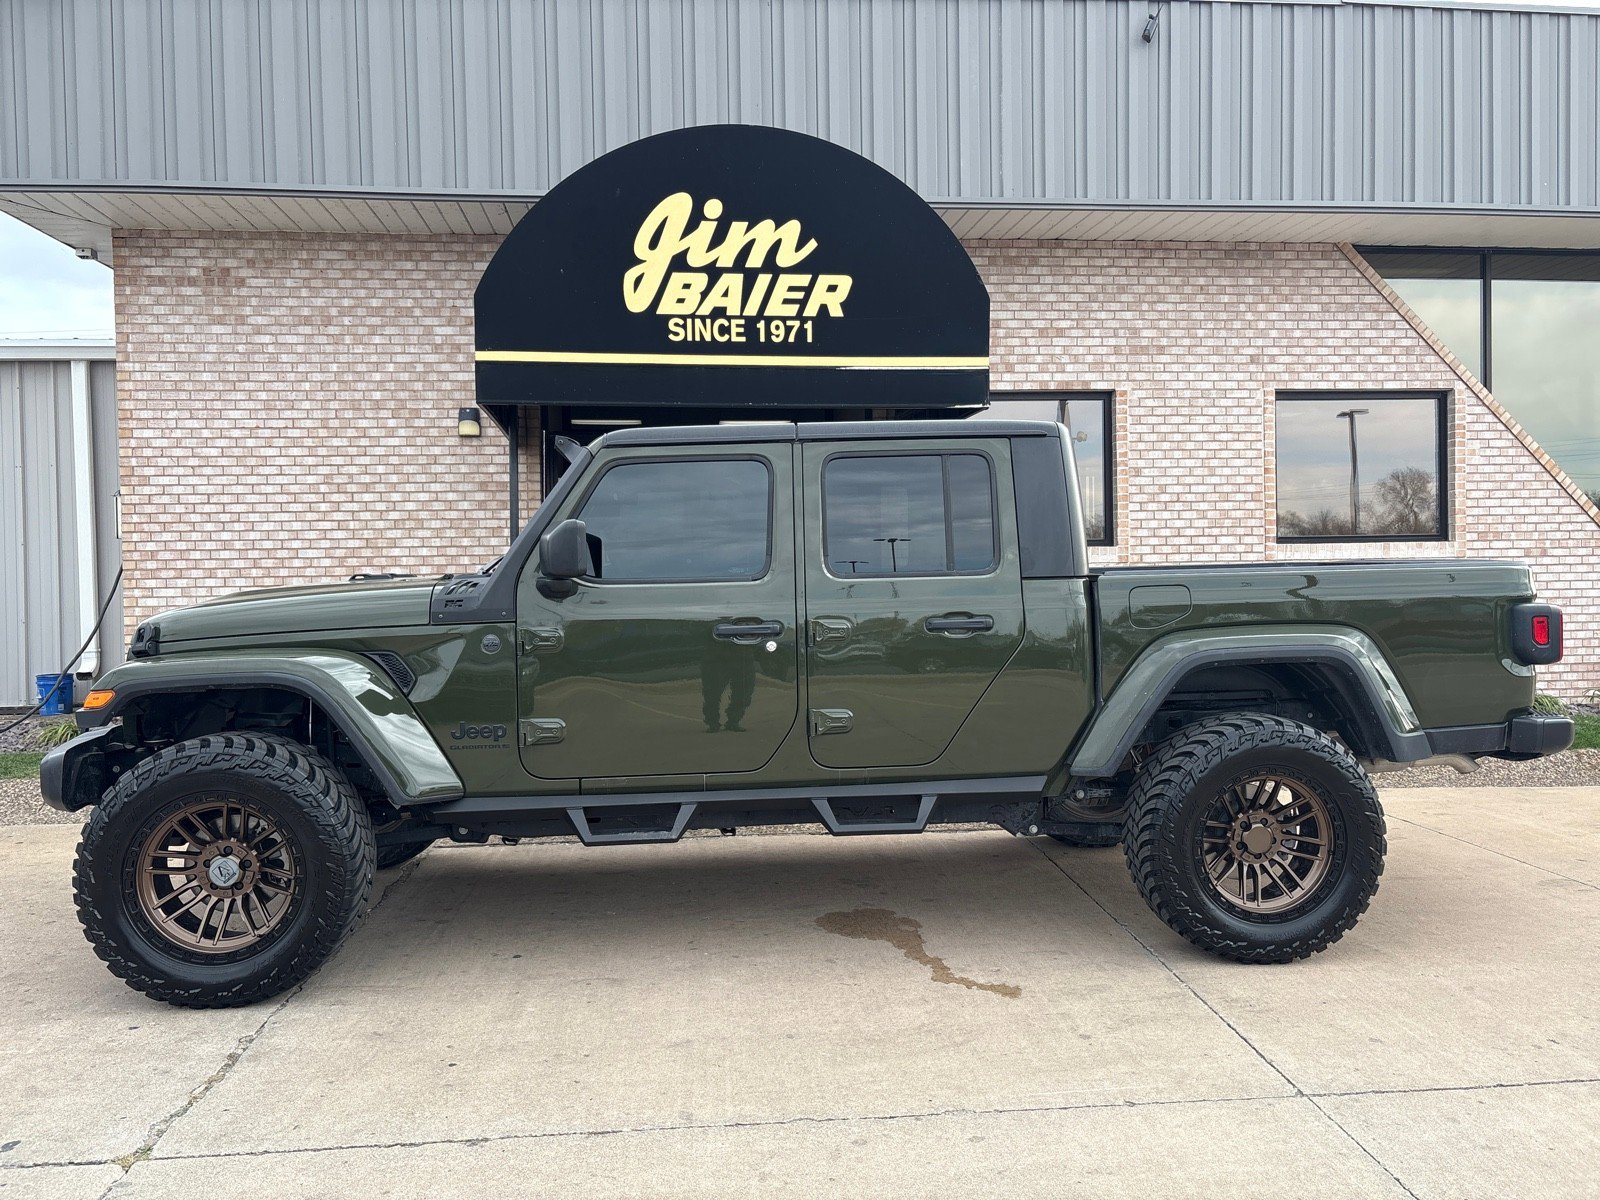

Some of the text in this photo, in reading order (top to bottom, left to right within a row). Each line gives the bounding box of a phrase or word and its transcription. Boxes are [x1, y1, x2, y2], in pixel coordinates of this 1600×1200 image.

[623, 191, 818, 313] Jim
[656, 272, 853, 317] BAIER
[668, 318, 813, 343] SINCE 1971
[450, 721, 507, 741] Jeep
